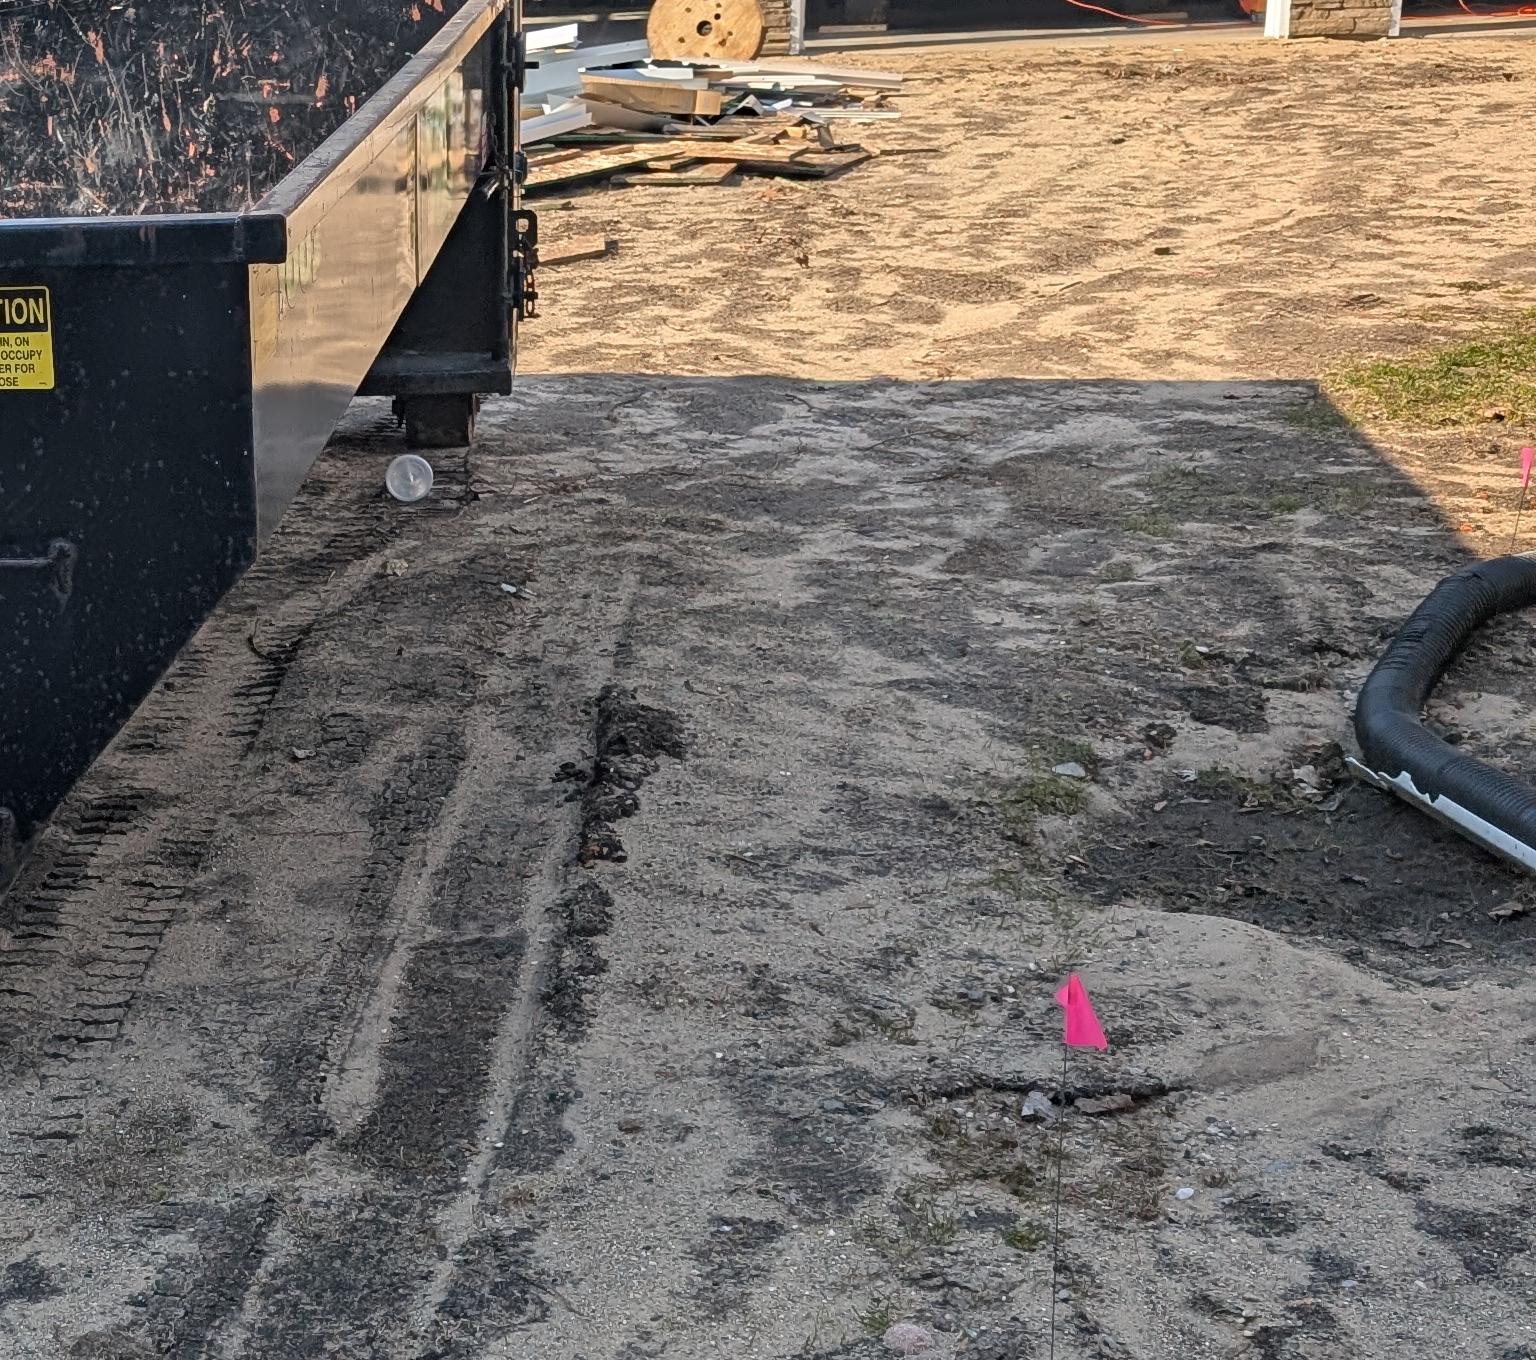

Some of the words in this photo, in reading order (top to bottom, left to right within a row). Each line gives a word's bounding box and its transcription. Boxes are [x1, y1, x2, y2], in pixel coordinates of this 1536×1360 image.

[0, 337, 13, 348] IN,
[15, 336, 30, 347] ON
[0, 350, 43, 360] OCCUPY
[15, 364, 35, 374] FOR
